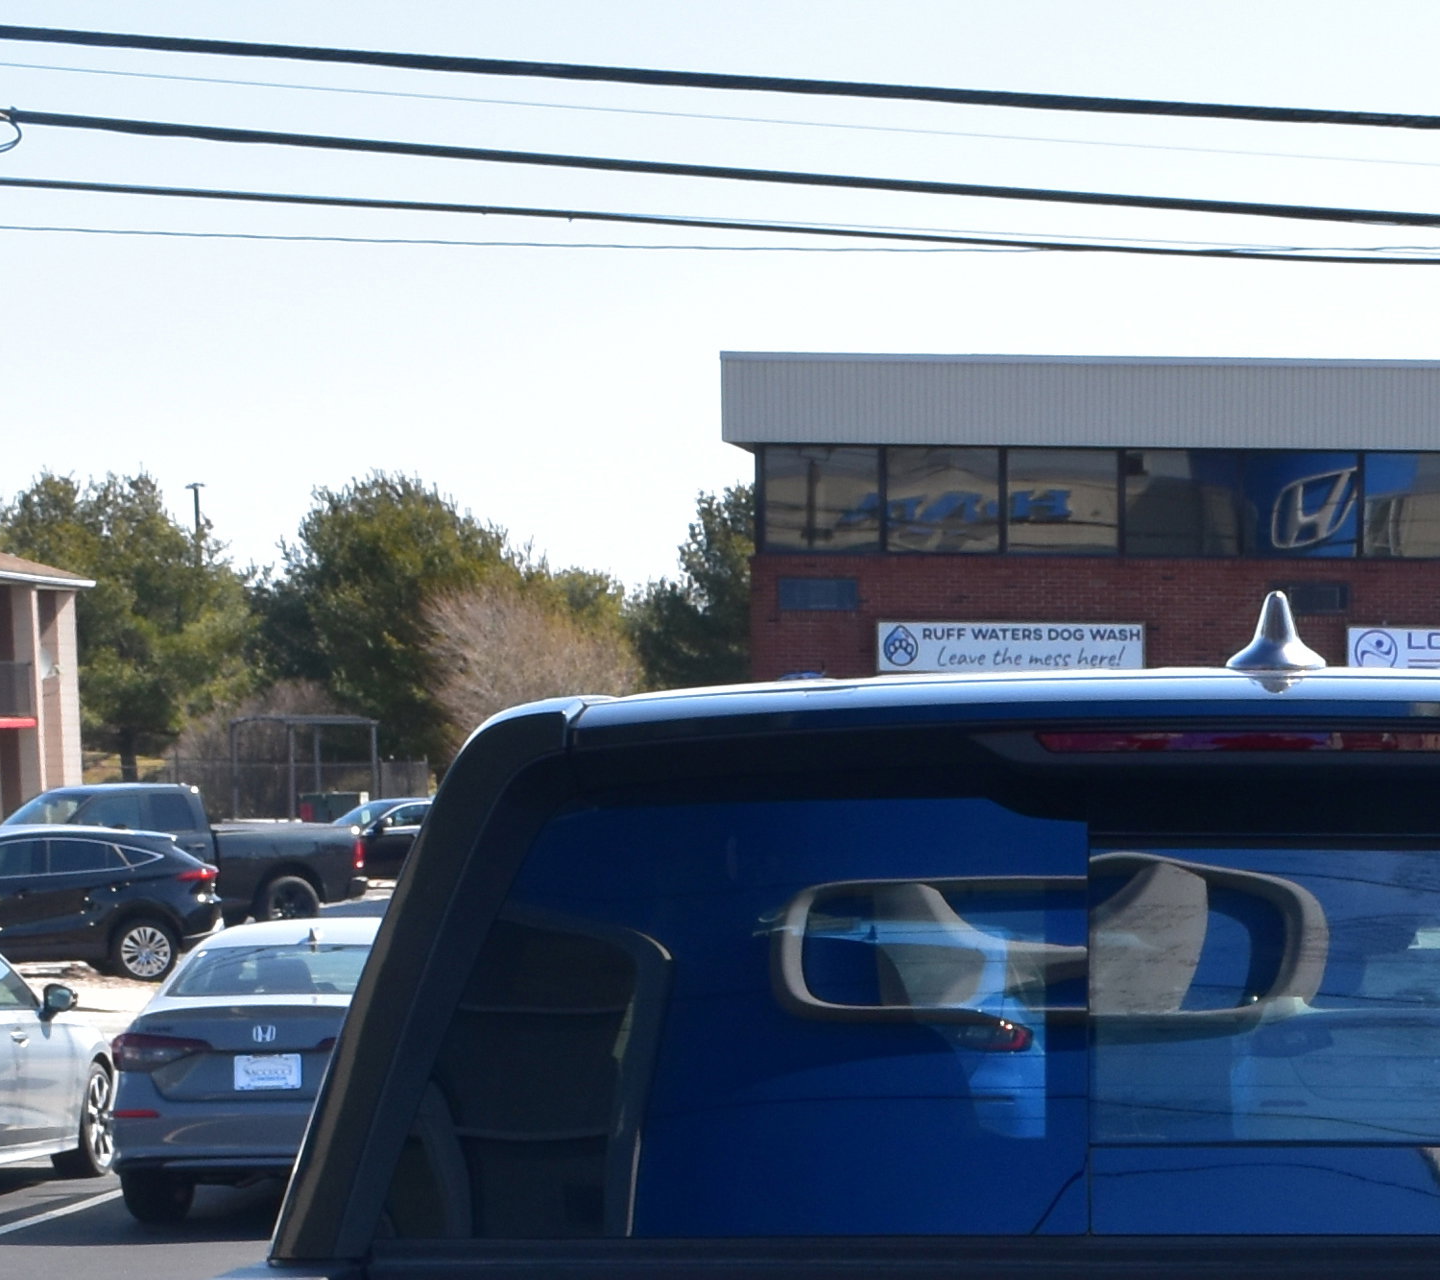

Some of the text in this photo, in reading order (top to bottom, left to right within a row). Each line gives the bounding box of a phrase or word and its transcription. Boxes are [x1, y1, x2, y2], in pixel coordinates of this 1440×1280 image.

[922, 627, 1141, 642] RUFF WATERS DOG WASH
[936, 646, 1126, 667] Leave the mess here!
